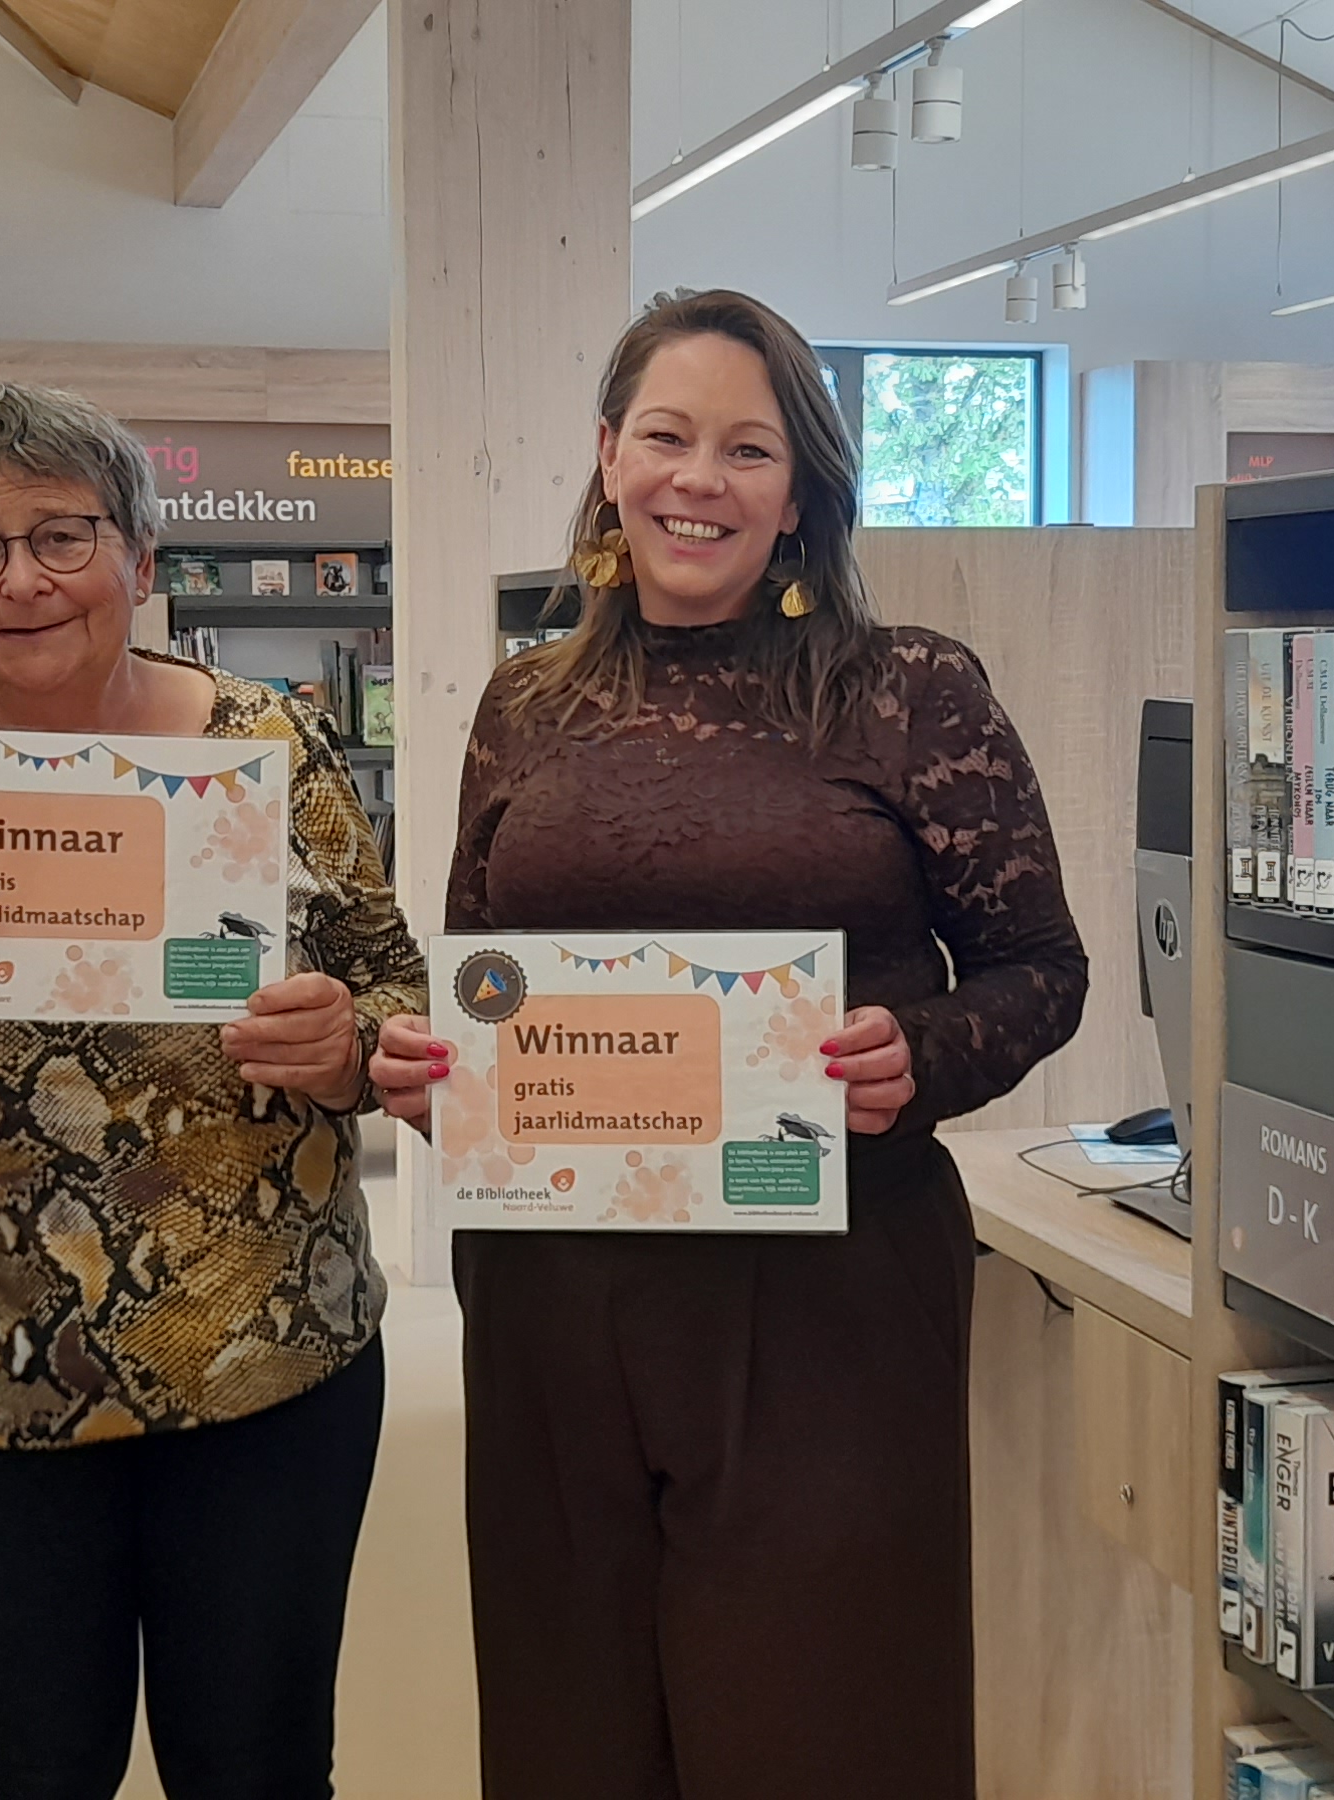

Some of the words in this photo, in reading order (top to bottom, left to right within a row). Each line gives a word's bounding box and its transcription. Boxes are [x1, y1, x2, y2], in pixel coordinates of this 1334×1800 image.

[514, 1023, 680, 1055] Winnaar
[514, 1077, 575, 1101] gratis
[513, 1111, 703, 1135] jaarlidmaatschap
[1261, 1125, 1327, 1175] ROMANS
[456, 1187, 473, 1200] de
[476, 1187, 552, 1201] Bibliotheek
[1275, 1433, 1293, 1512] ENGER
